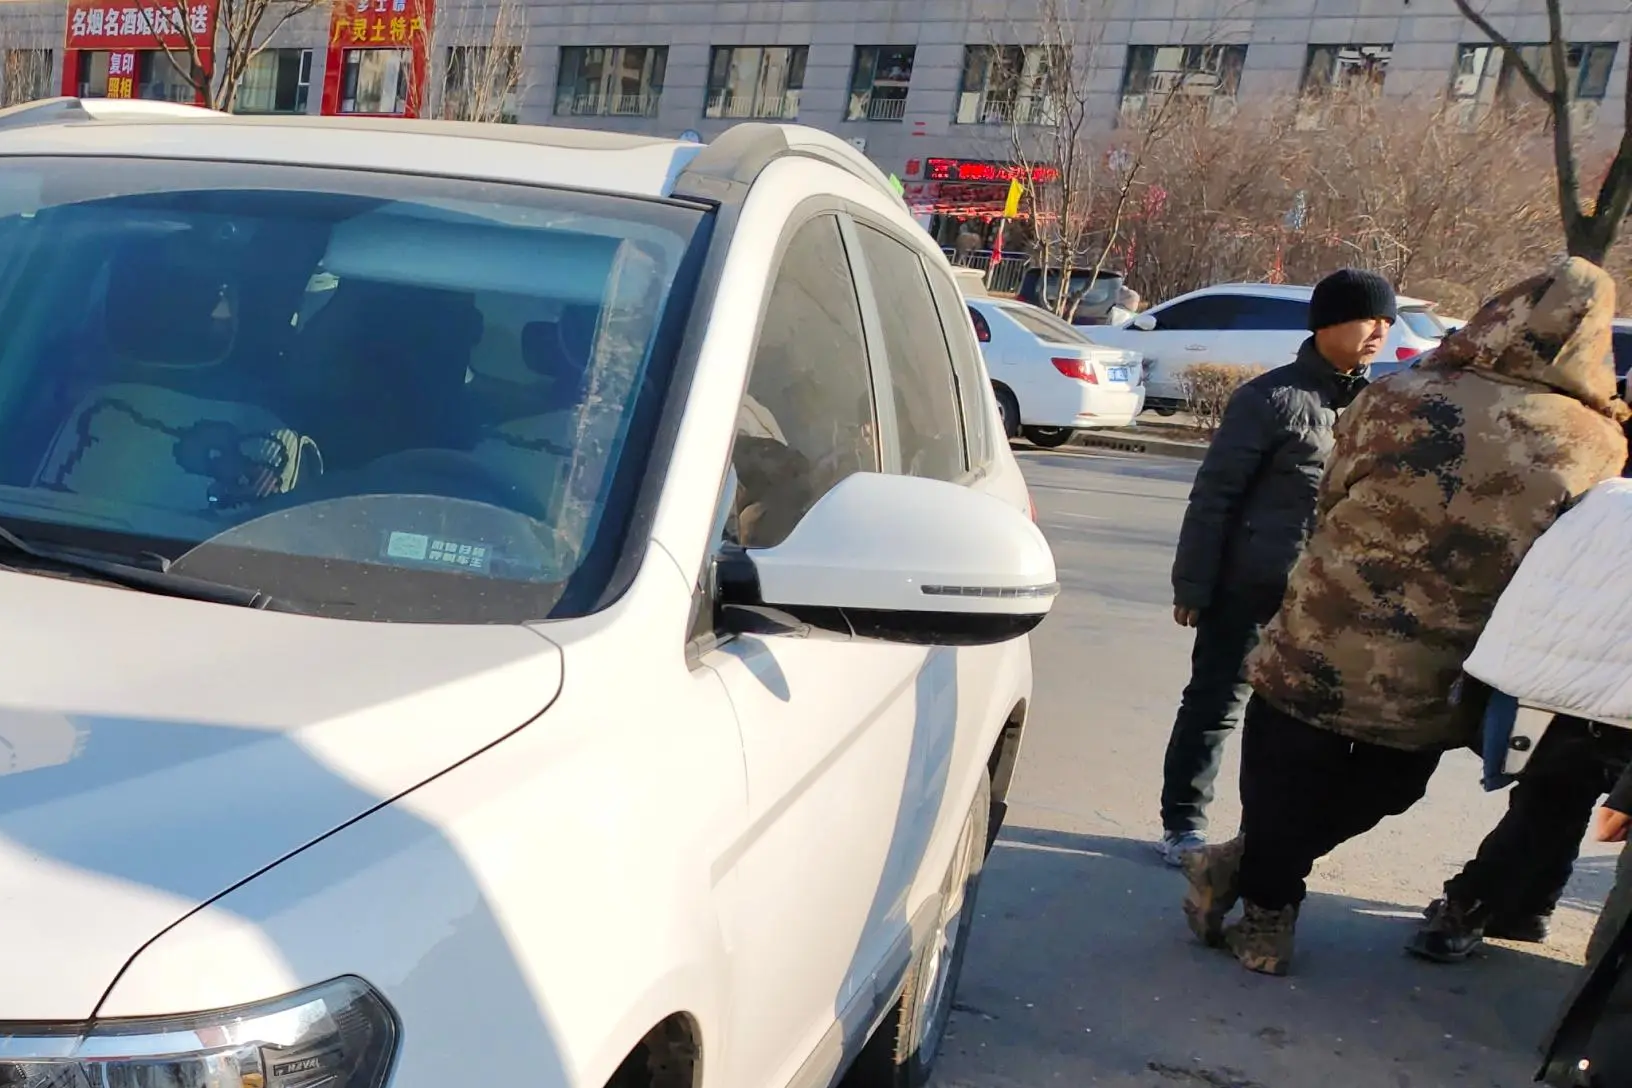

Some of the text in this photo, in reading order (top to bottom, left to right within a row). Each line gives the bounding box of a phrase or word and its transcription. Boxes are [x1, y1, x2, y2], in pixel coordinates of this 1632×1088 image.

[332, 16, 422, 43] 广灵土特产
[109, 53, 134, 74] 复印
[108, 77, 132, 98] 照相
